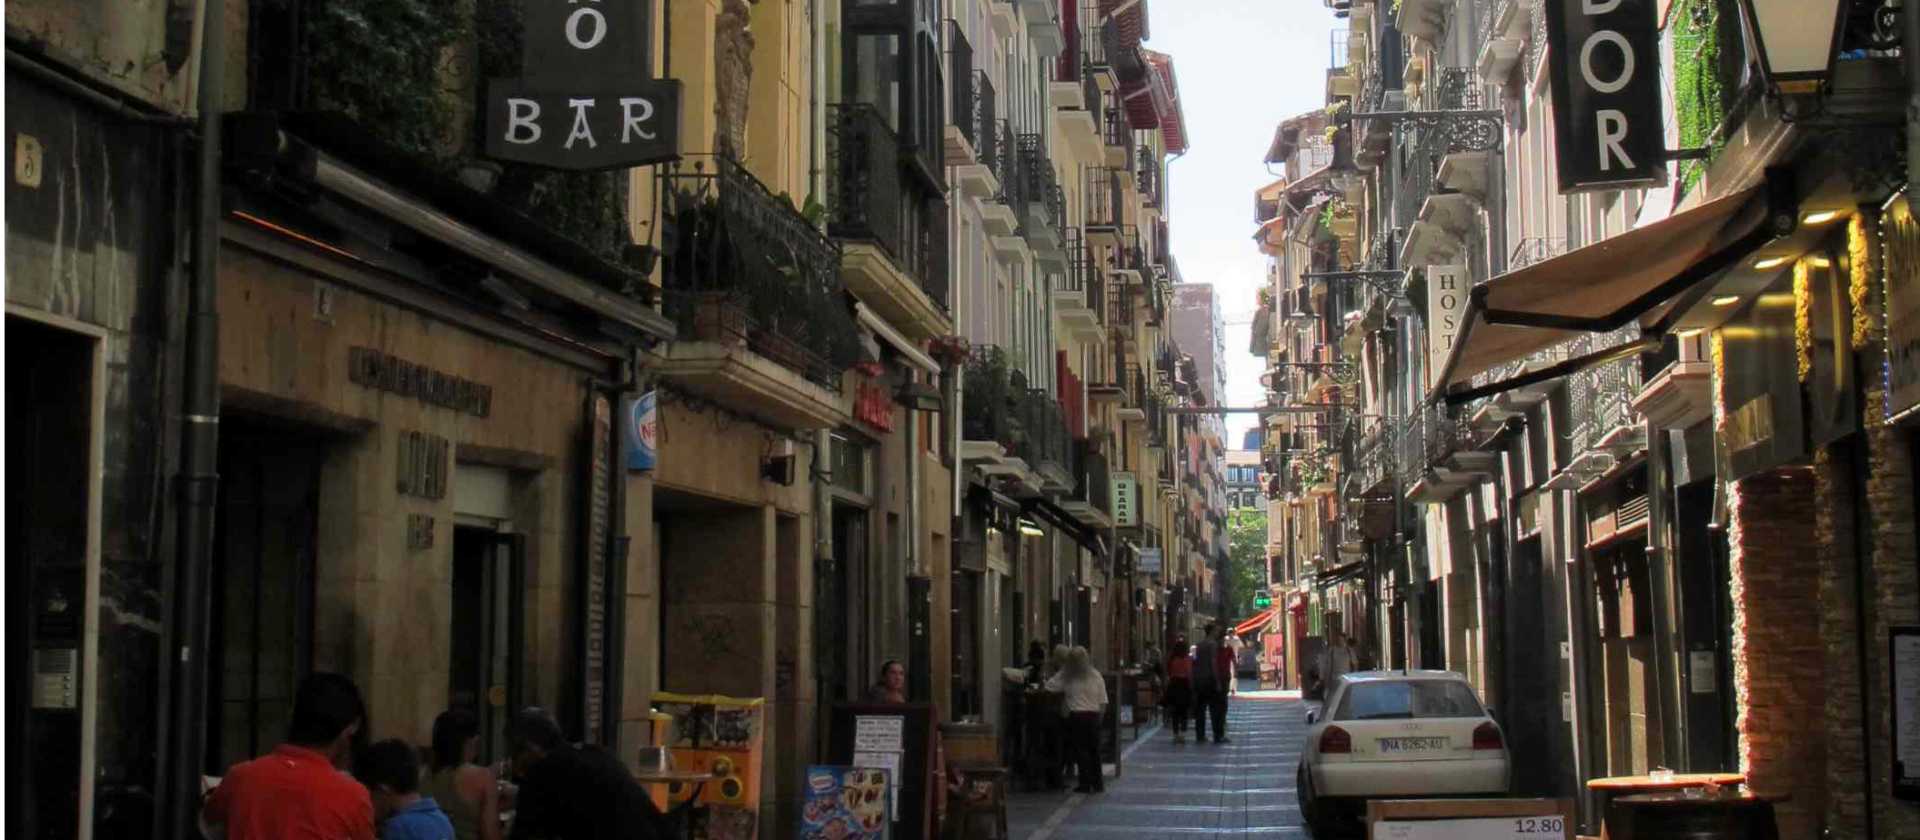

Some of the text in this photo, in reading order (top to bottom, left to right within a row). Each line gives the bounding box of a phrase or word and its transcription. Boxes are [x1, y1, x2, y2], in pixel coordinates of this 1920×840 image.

[565, 0, 608, 50] O
[1580, 0, 1635, 171] OR
[504, 97, 656, 149] BAR
[1515, 819, 1562, 833] 12.80
